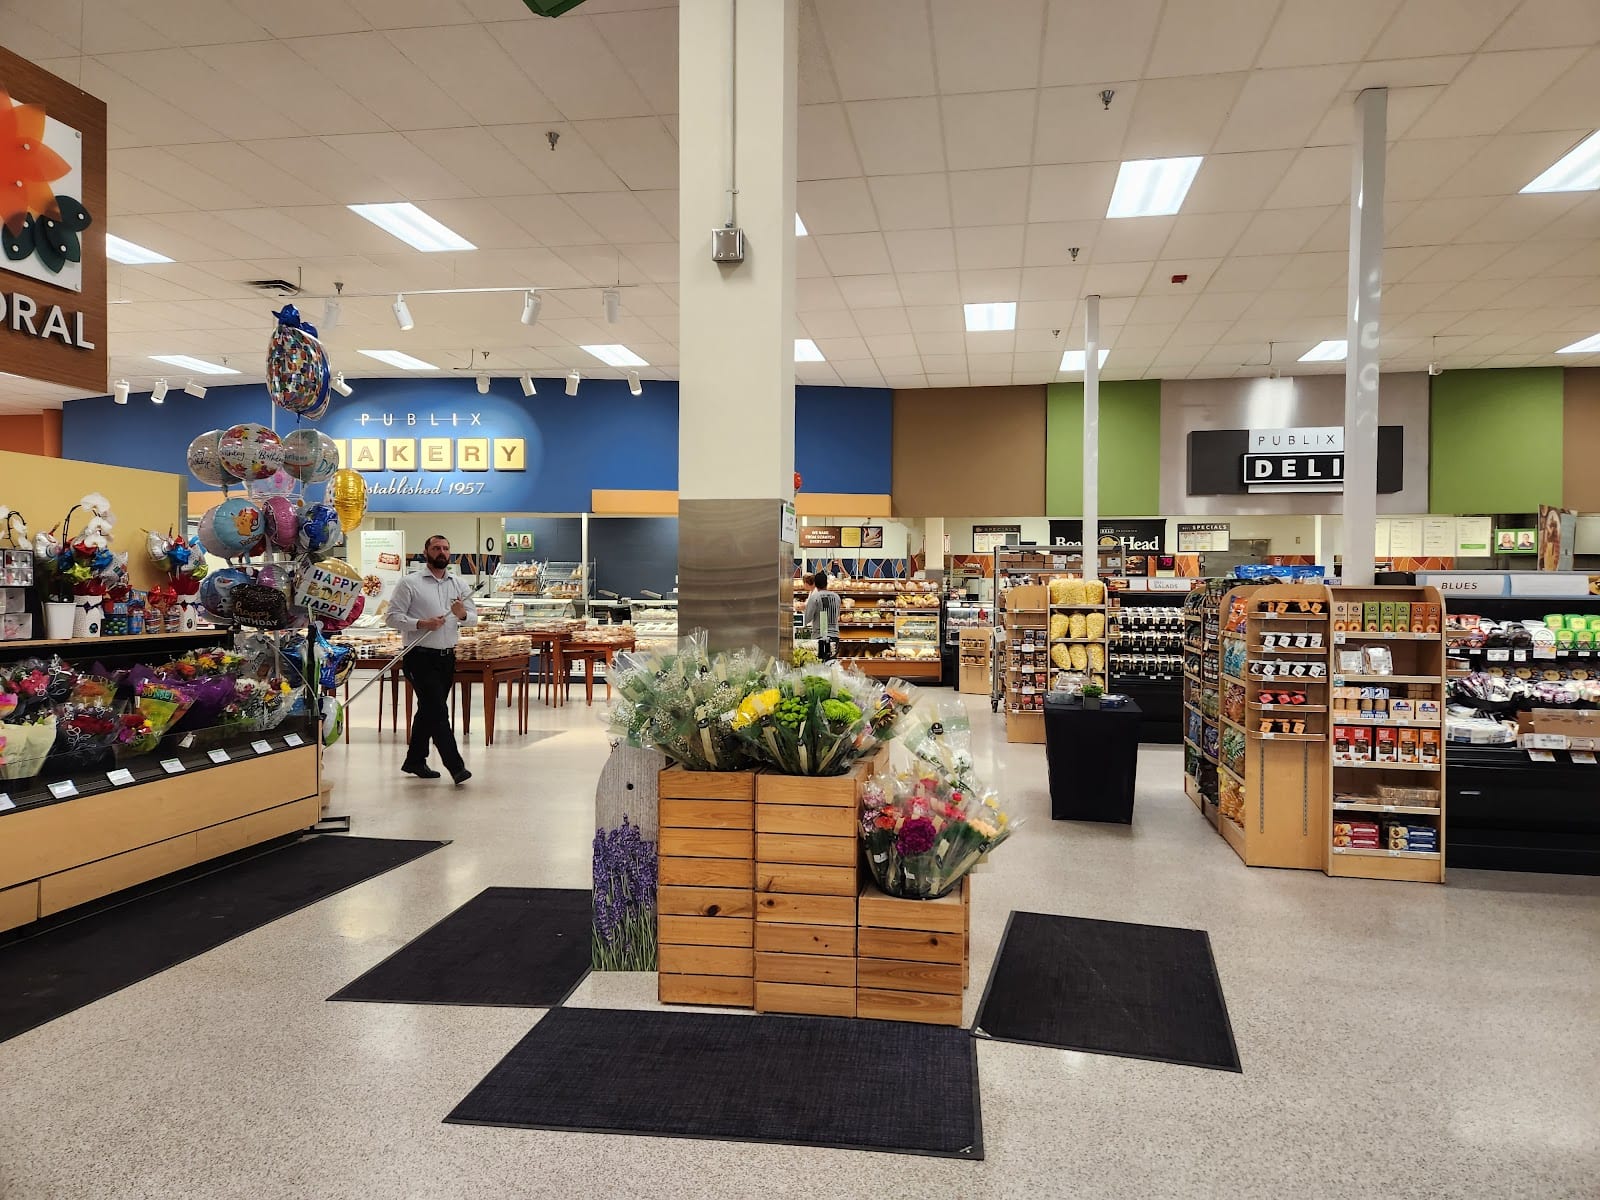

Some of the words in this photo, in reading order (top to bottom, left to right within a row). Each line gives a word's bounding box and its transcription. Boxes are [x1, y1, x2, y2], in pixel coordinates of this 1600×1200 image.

[0, 291, 95, 350] RAL
[360, 412, 482, 427] PUBLIX
[1257, 434, 1336, 447] PUBLIX
[356, 444, 518, 463] AKERY
[1254, 457, 1341, 478] DELI
[367, 476, 445, 495] stablished
[448, 481, 486, 495] 1957
[1119, 535, 1160, 551] Head
[313, 569, 359, 592] HAPPY
[1440, 581, 1479, 591] BLUES
[300, 595, 347, 617] HAPPY
